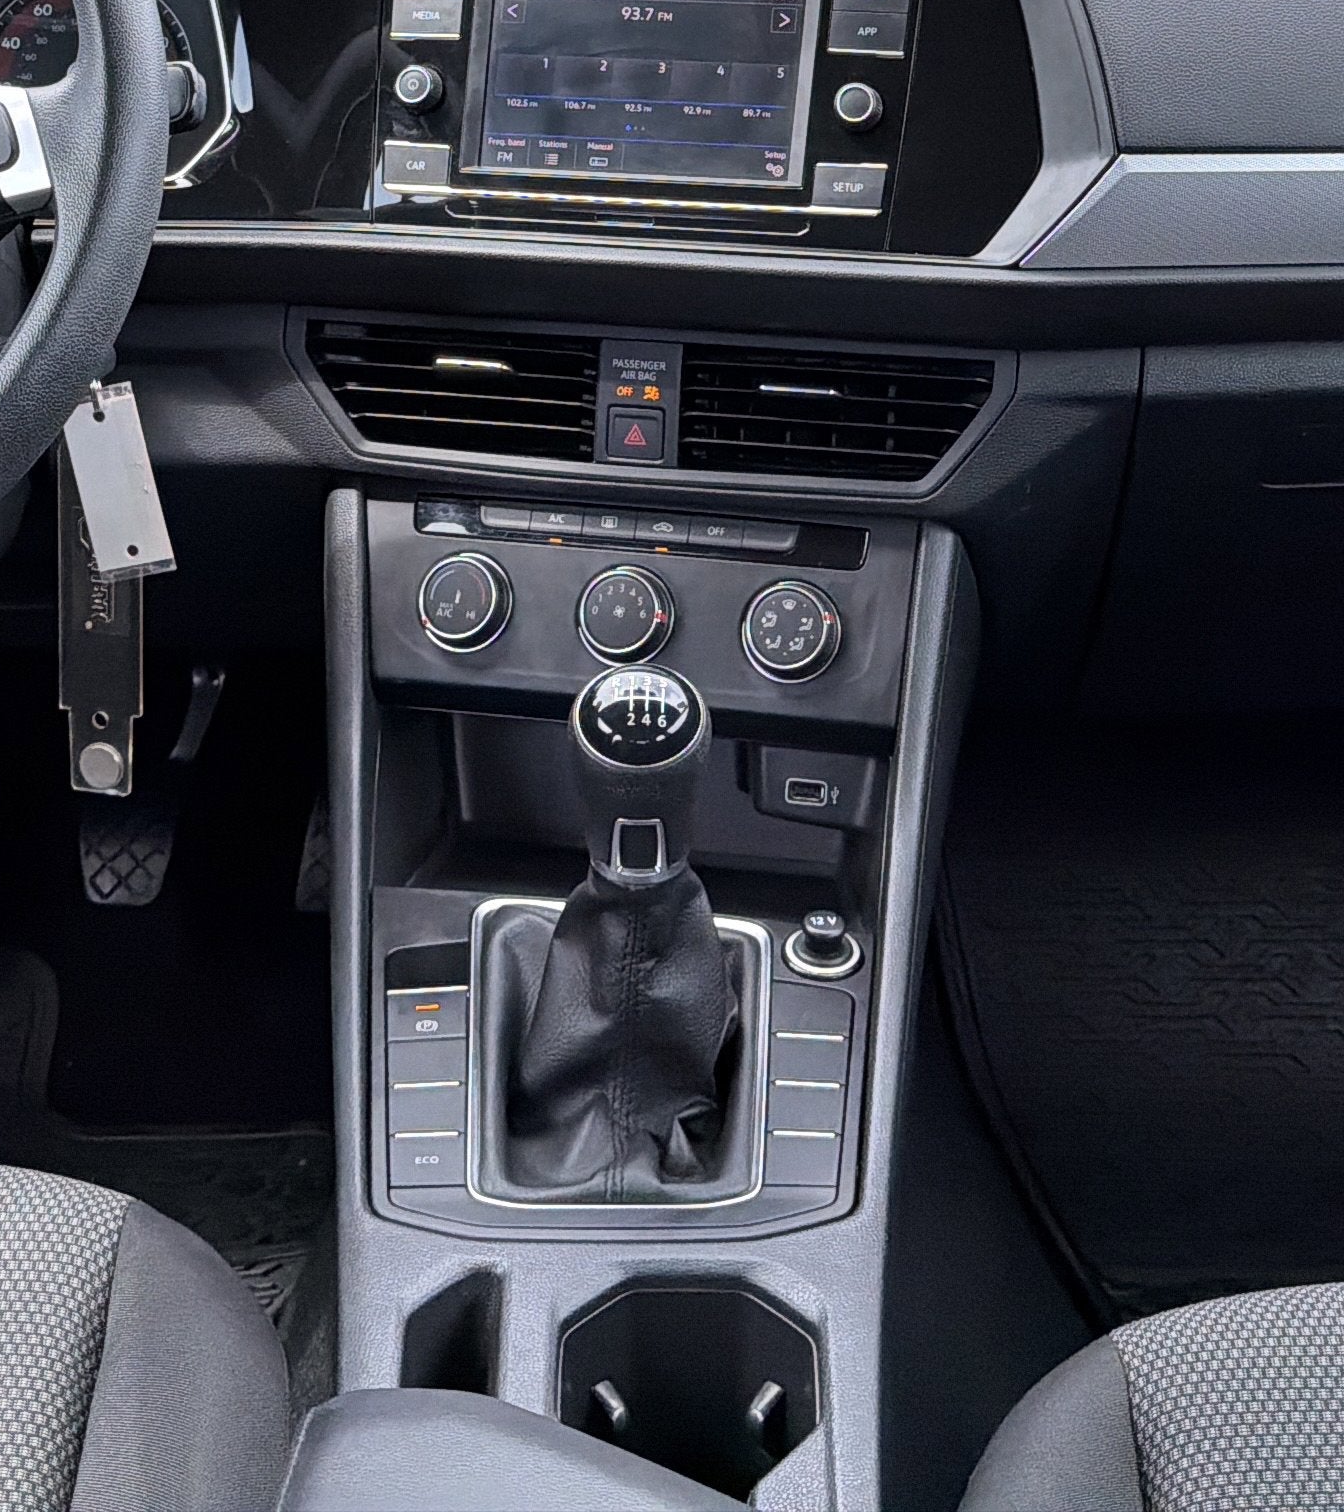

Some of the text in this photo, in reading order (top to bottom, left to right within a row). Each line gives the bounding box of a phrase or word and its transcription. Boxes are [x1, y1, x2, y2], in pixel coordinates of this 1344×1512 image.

[33, 3, 53, 17] 60
[412, 10, 441, 21] MEDIA
[621, 6, 673, 22] 93.7 FM
[857, 26, 878, 36] APP
[0, 36, 21, 50] 40
[543, 57, 785, 79] 1 2 3 4 5
[506, 97, 529, 108] 102.5
[564, 100, 587, 110] 106.7
[624, 103, 642, 112] 92.5
[682, 105, 702, 115] 92.9
[742, 108, 761, 118] 89.7
[538, 139, 569, 149] Stations
[586, 141, 614, 151] Manual
[496, 151, 514, 163] FM
[764, 150, 787, 160] Setup
[405, 160, 426, 171] CAR
[832, 181, 865, 193] SETUP
[612, 358, 666, 371] PASSENGER
[620, 370, 657, 381] AIR BAG
[616, 385, 634, 397] OFF
[549, 514, 565, 524] A/C
[707, 526, 725, 537] OFF
[435, 608, 454, 619] A/C
[465, 610, 476, 620] HI
[639, 609, 647, 619] 6
[643, 676, 652, 686] 3
[626, 713, 667, 728] 2 4 6
[809, 915, 837, 927] 12 V
